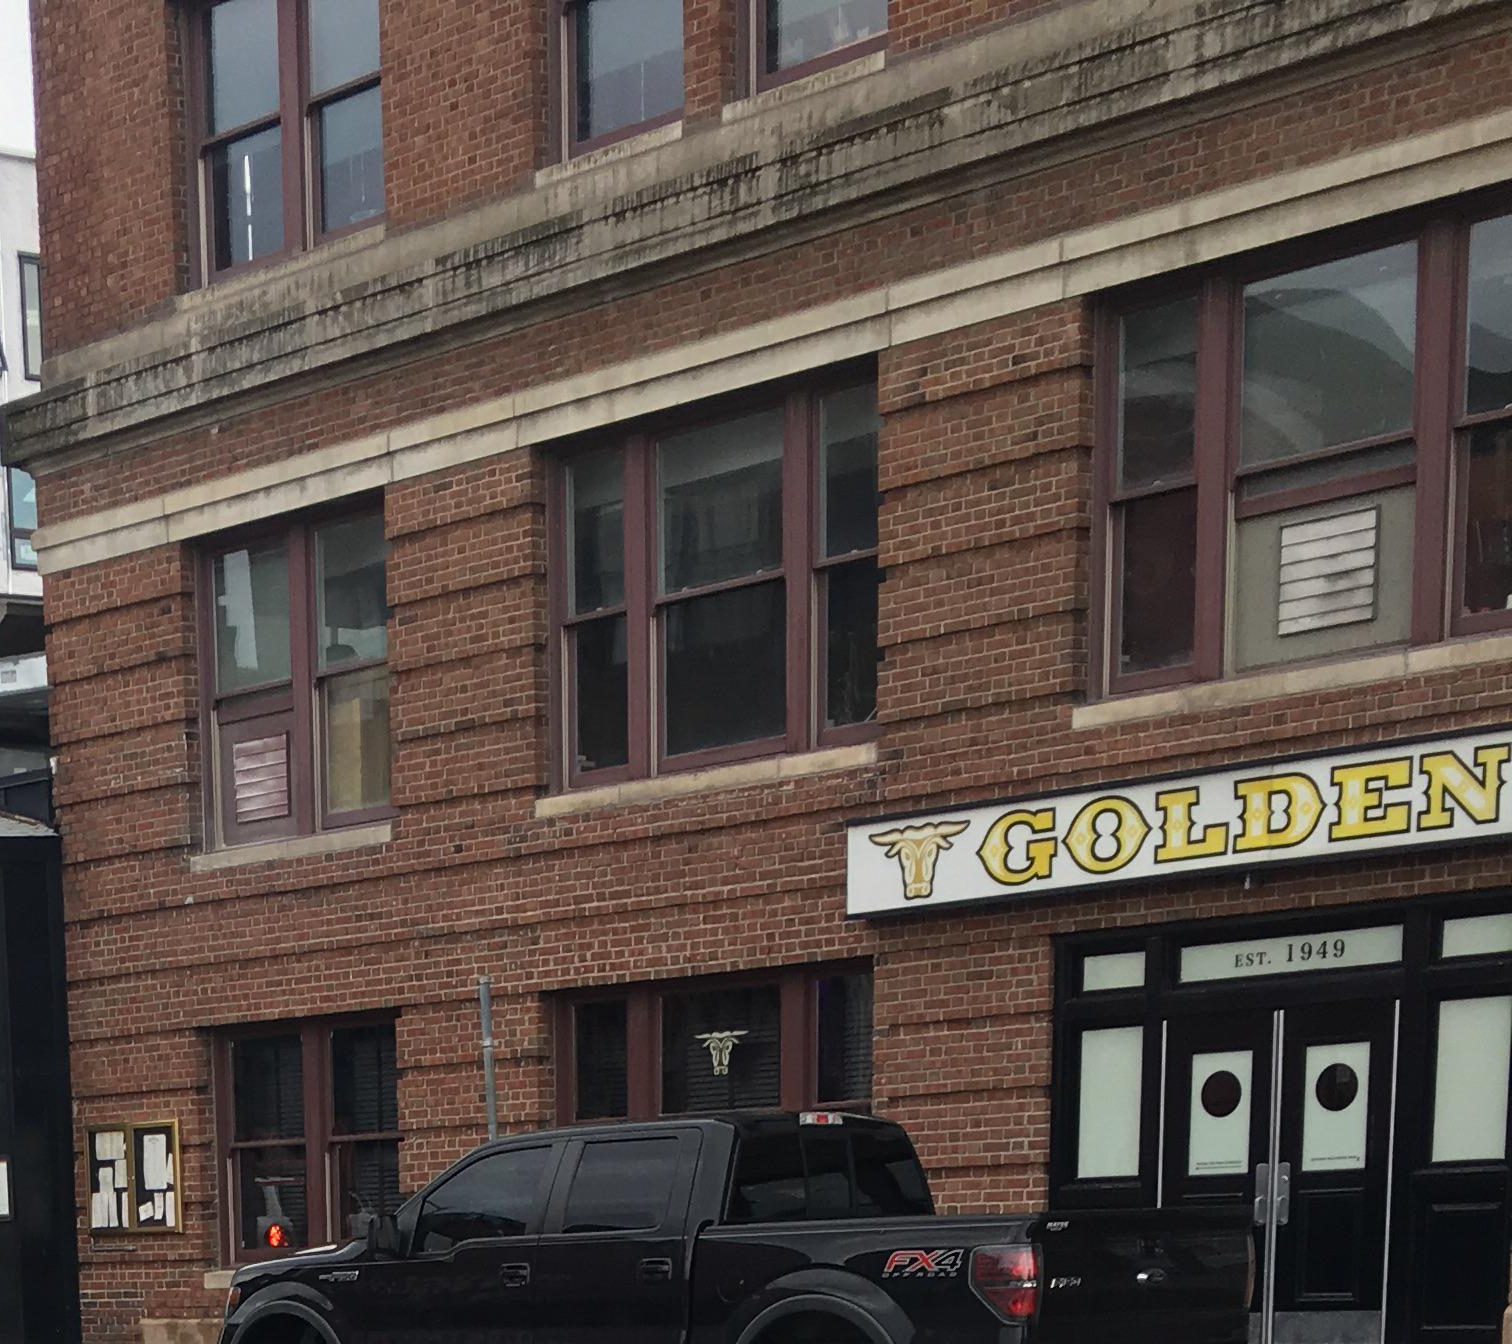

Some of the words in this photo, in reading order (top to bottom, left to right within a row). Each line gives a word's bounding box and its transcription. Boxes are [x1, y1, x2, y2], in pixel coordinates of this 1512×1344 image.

[976, 742, 1511, 886] GOLDEN
[1234, 951, 1271, 969] EST.
[1286, 938, 1346, 964] 1949
[883, 1249, 965, 1273] FX4
